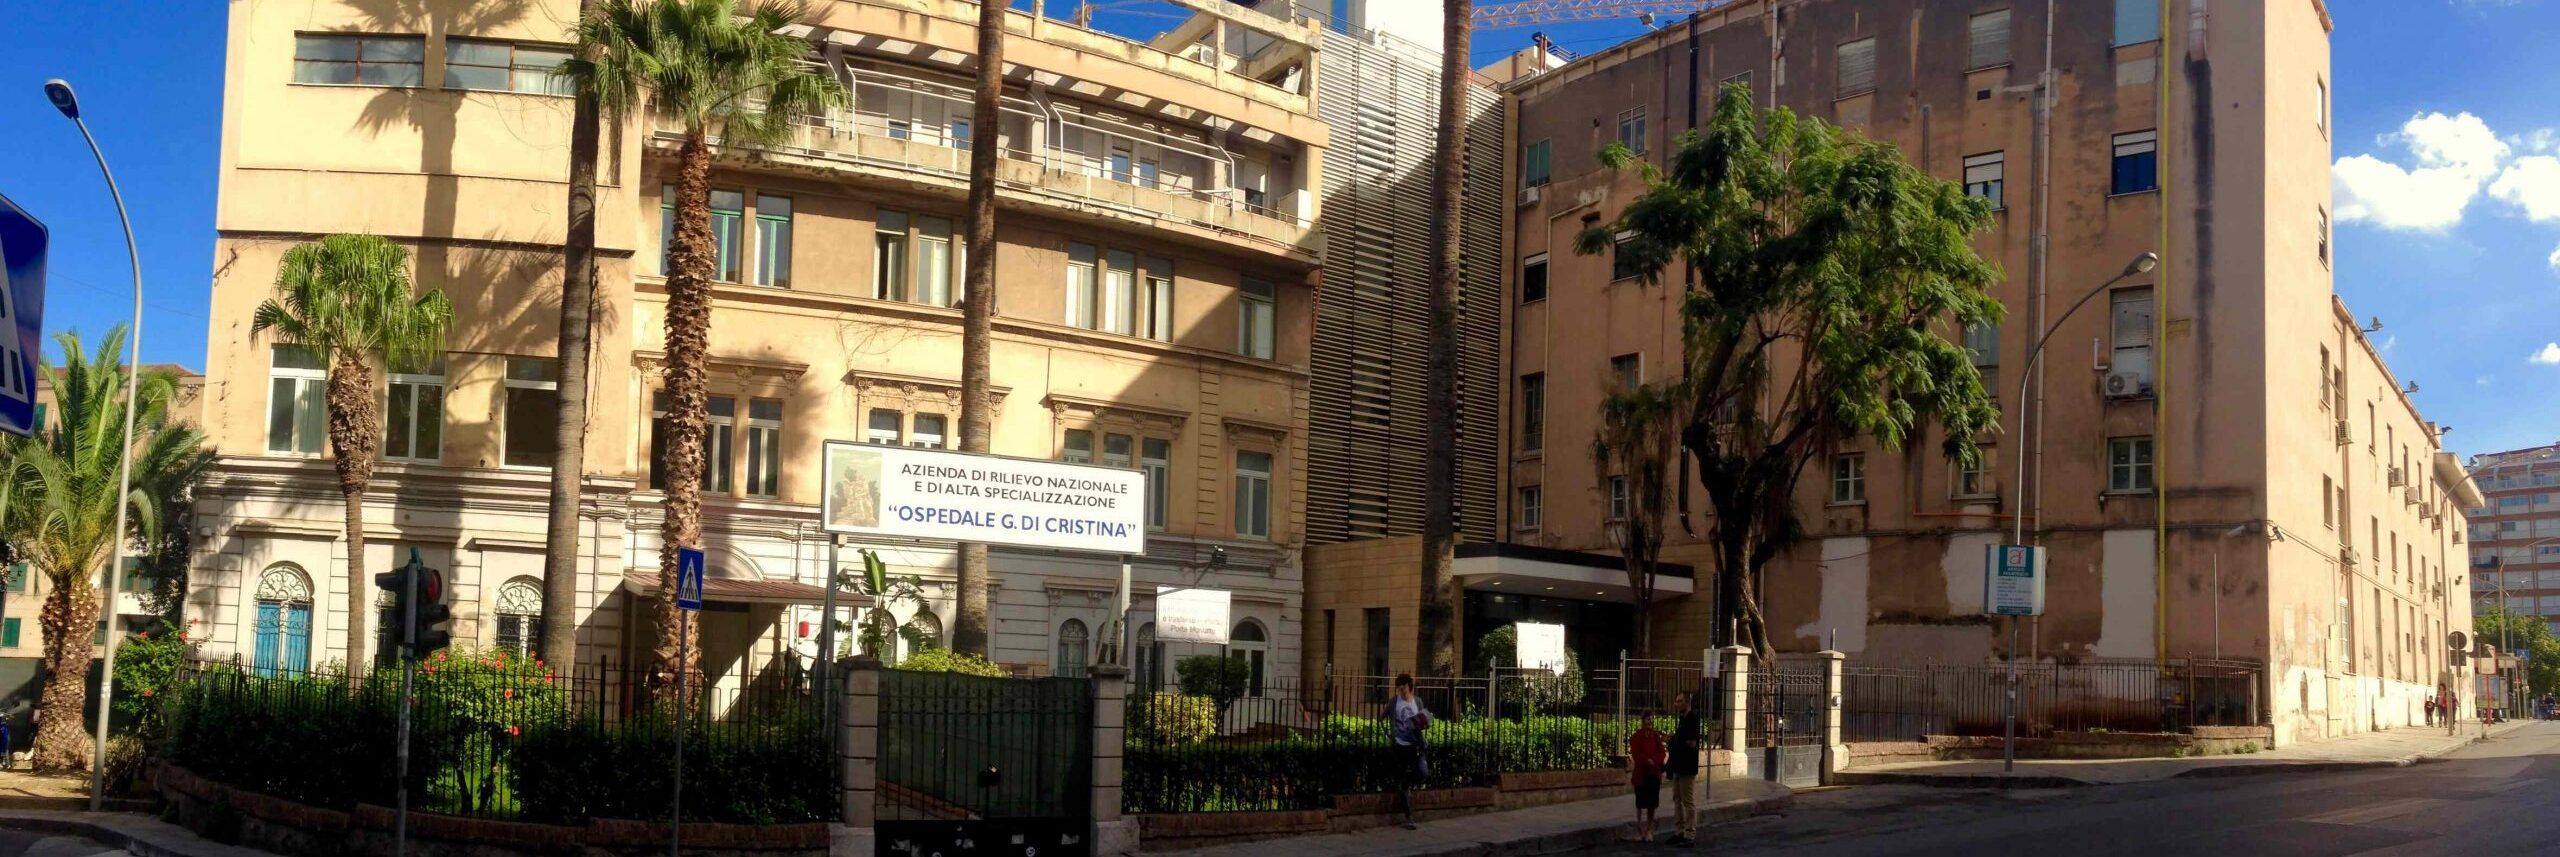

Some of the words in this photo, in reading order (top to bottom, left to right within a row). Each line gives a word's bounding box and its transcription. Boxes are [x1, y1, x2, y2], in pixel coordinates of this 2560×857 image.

[901, 463, 968, 480] AZIENDA
[971, 470, 986, 481] DI
[990, 471, 1043, 487] RILIEVO
[1047, 476, 1128, 494] NAZIONALE
[914, 481, 922, 492] E
[927, 482, 942, 494] DI
[945, 483, 980, 497] ALTA
[984, 486, 1116, 509] SPECIALIZZAZIONE
[1001, 513, 1017, 530] G.
[1021, 515, 1039, 531] DI
